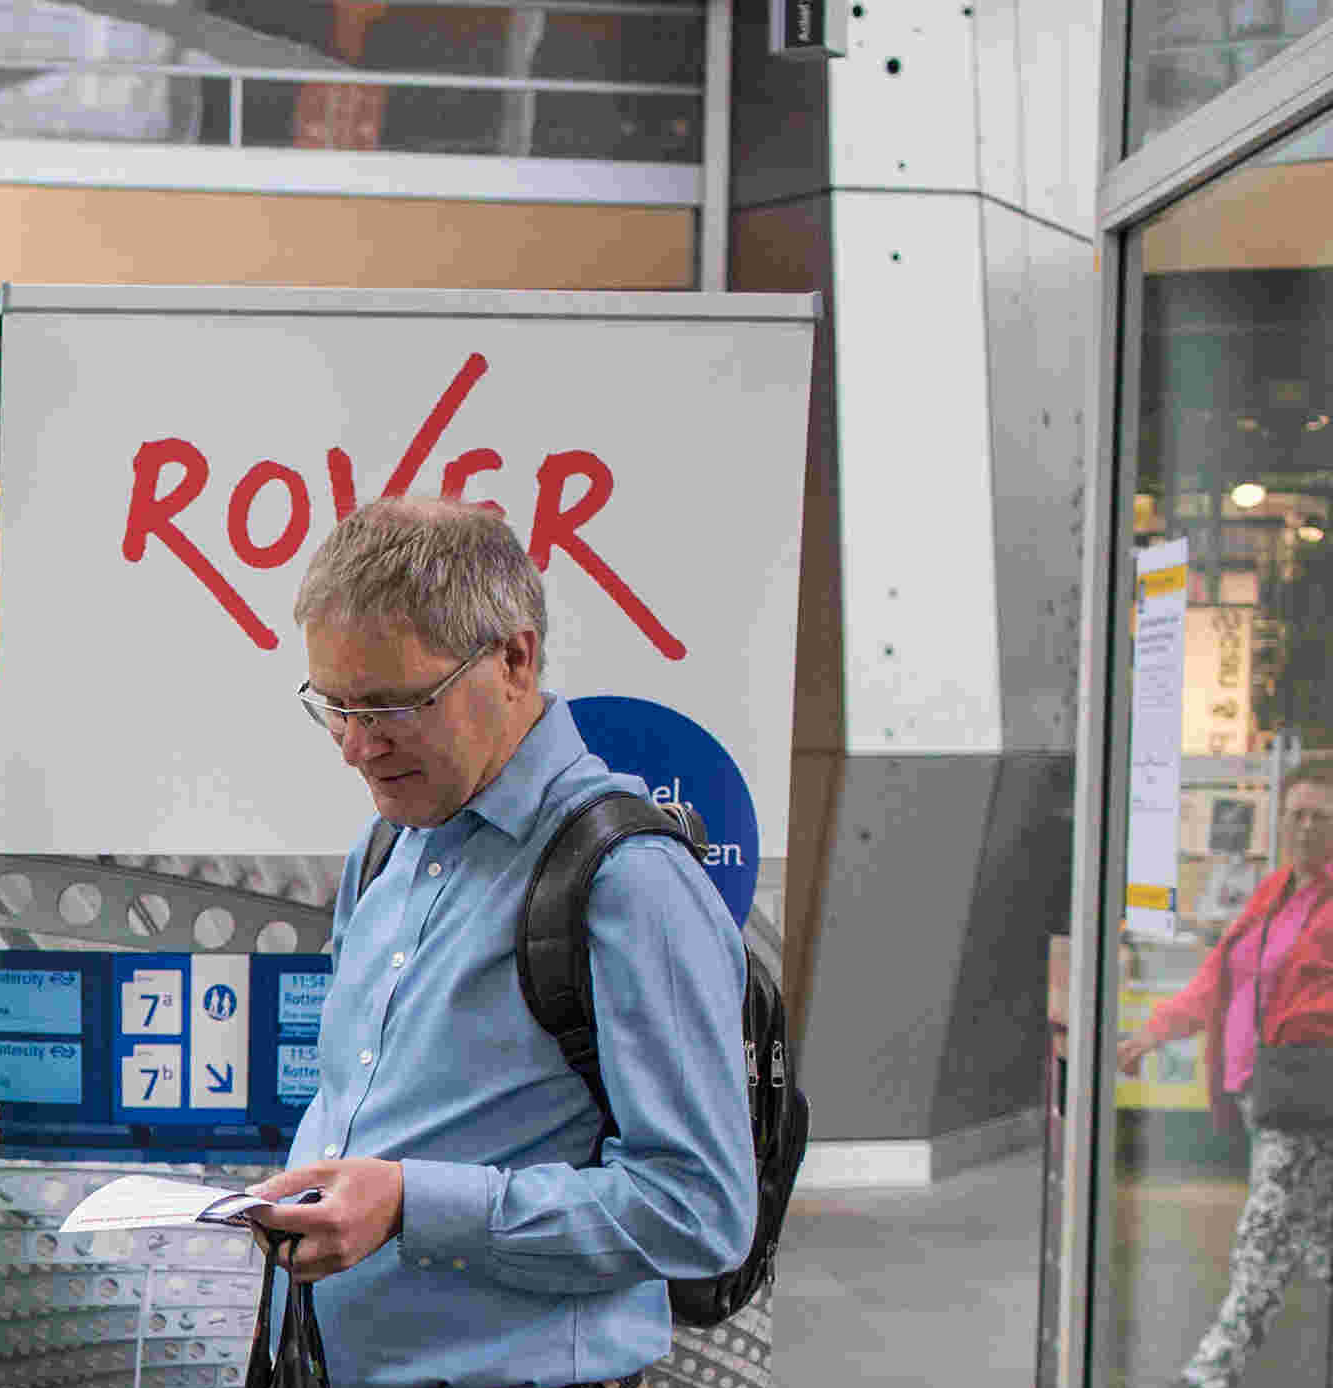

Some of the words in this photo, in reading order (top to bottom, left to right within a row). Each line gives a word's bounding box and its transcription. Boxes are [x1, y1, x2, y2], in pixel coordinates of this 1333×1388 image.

[122, 352, 687, 661] ROVER
[652, 777, 694, 812] el,
[702, 842, 743, 866] en
